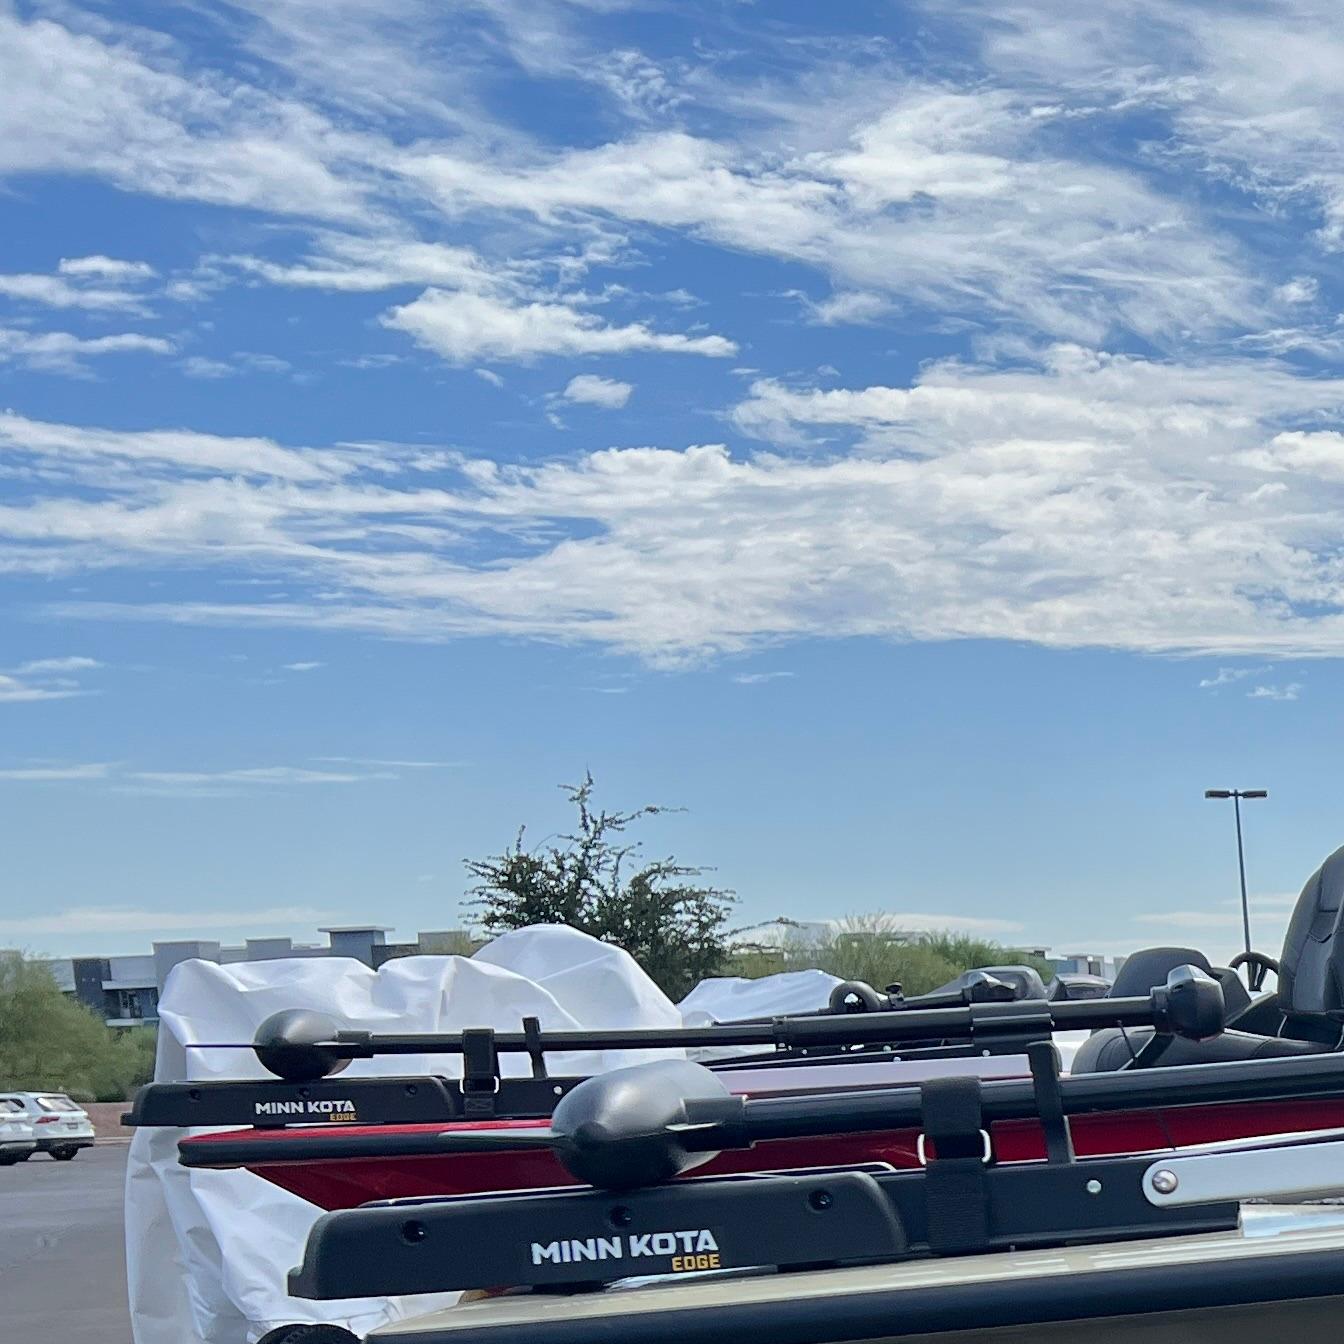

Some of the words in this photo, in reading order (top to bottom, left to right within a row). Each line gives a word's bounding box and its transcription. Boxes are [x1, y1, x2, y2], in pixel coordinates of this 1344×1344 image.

[255, 1102, 305, 1115] MINN
[307, 1100, 355, 1113] KOTA
[329, 1113, 357, 1121] EDGE
[531, 1236, 623, 1265] MINN
[629, 1229, 719, 1258] KOTA
[671, 1253, 720, 1272] EDGE
